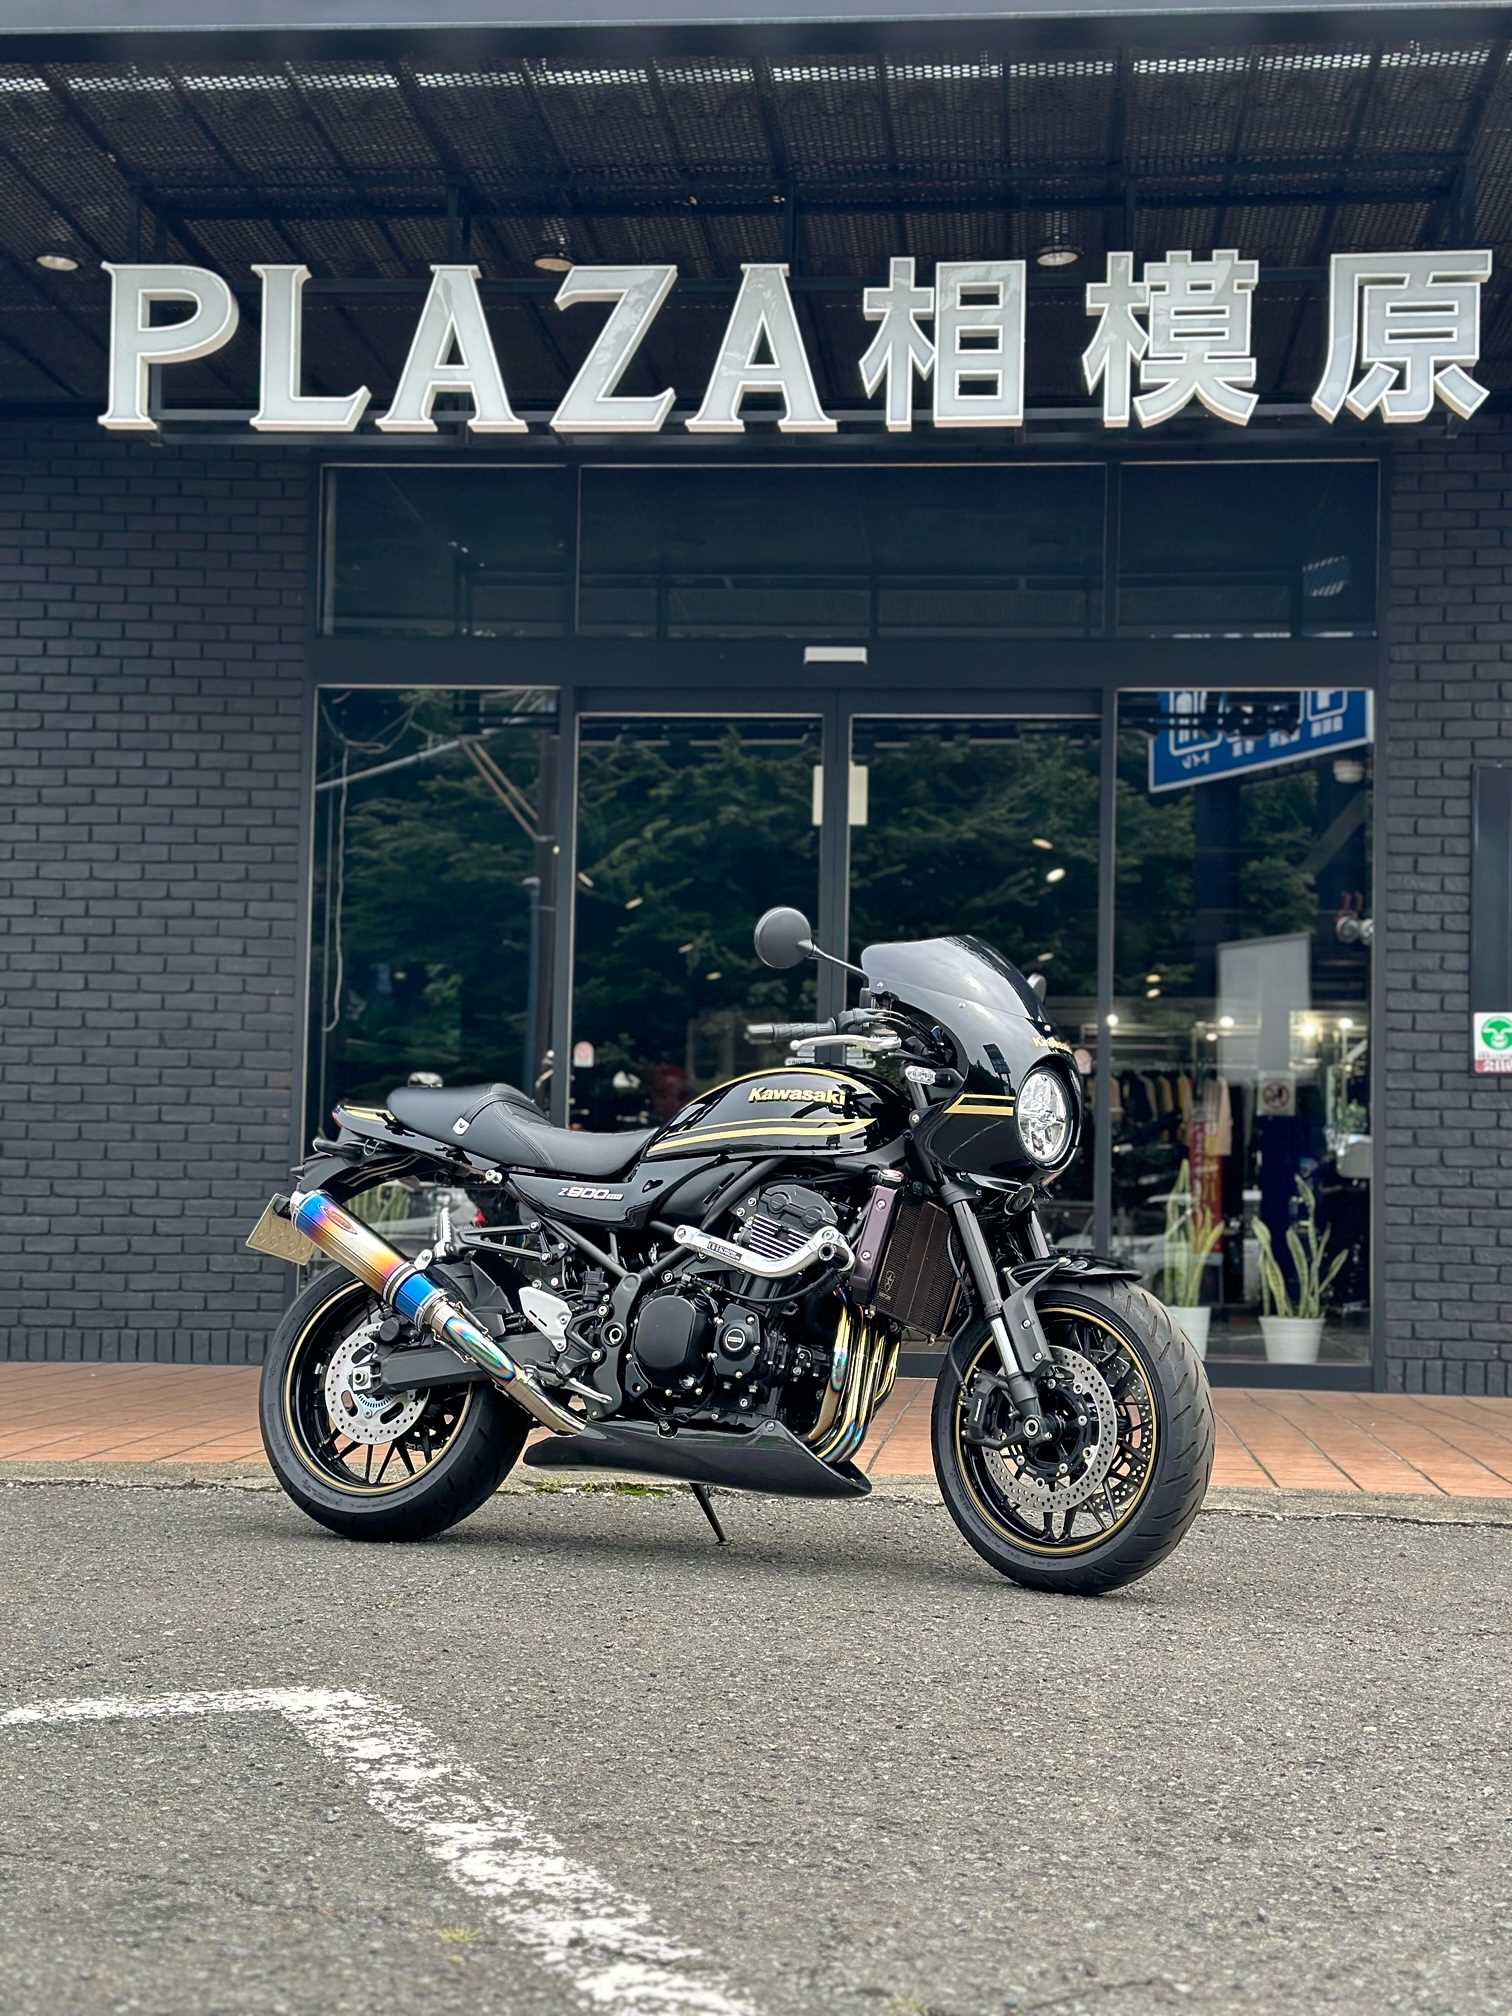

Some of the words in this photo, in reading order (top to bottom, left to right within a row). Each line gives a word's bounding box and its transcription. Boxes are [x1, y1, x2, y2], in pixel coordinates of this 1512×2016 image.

[98, 260, 838, 433] PLAZA
[859, 249, 1493, 432] 相模原
[748, 1087, 846, 1106] Kawasaki
